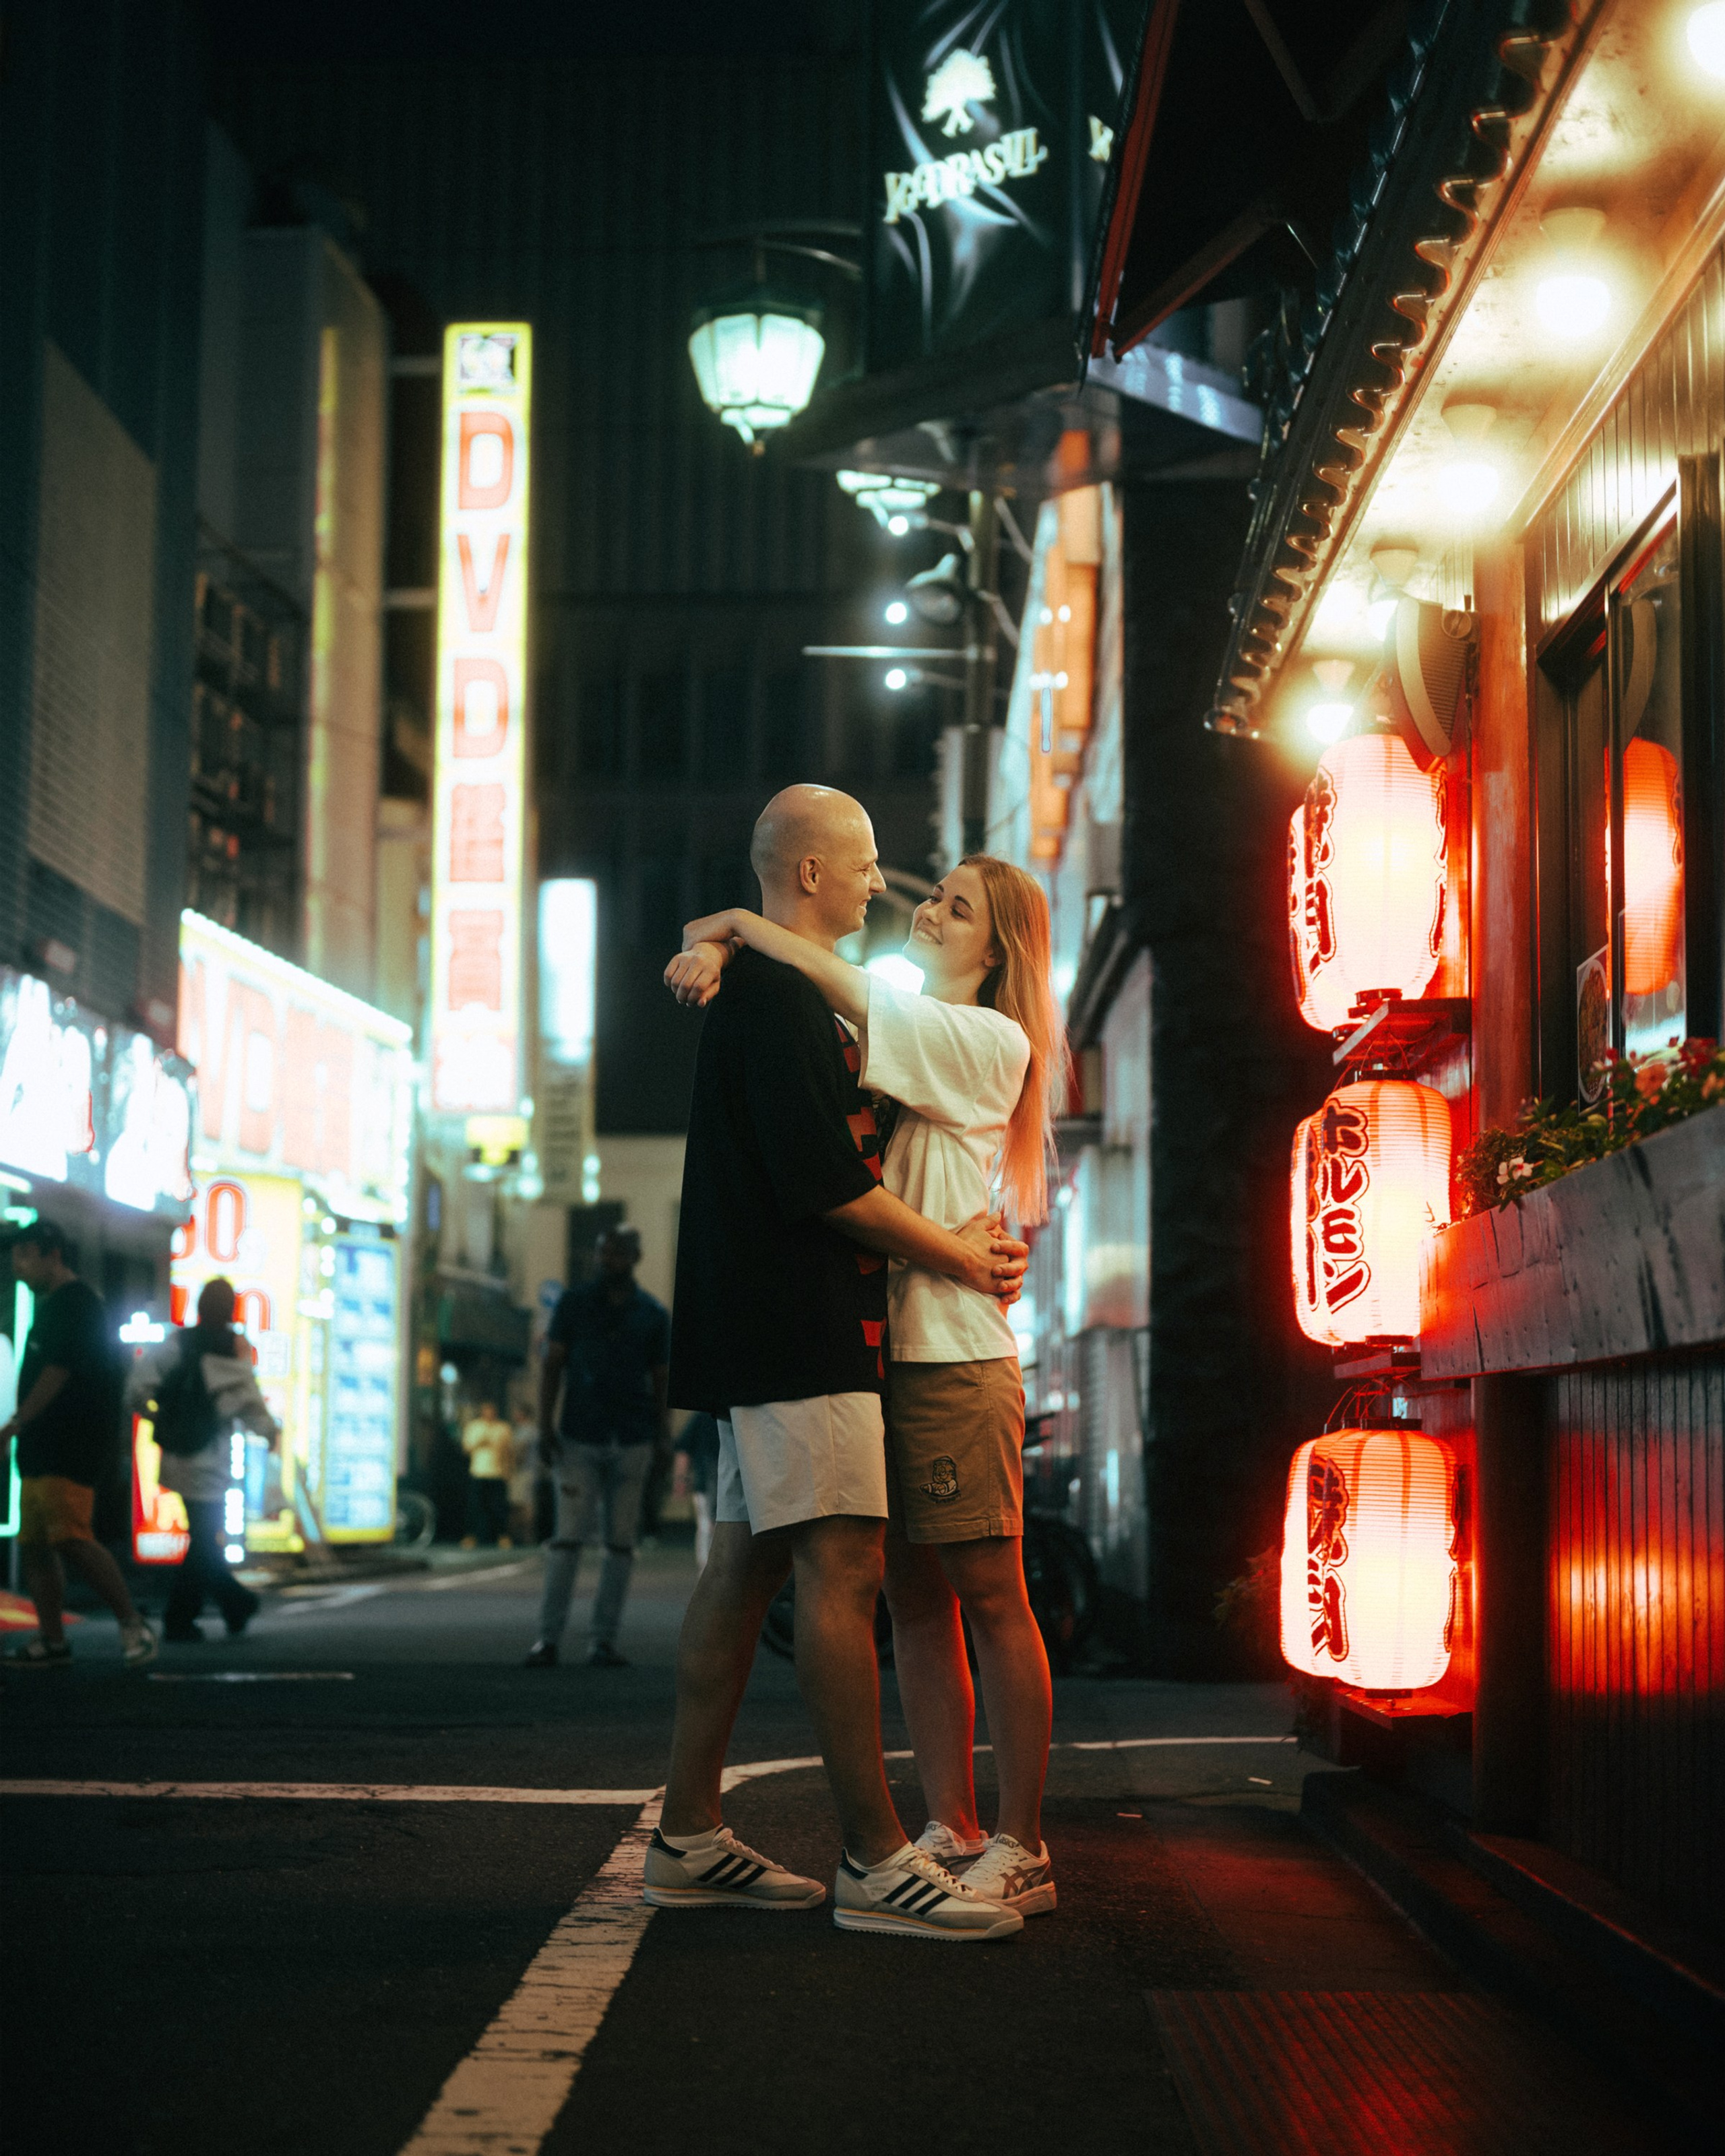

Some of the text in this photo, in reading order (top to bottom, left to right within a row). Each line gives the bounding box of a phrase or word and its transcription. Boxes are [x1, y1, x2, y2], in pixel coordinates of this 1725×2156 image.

[1321, 1100, 1371, 1314] ホルモン
[999, 1837, 1016, 1849] asics
